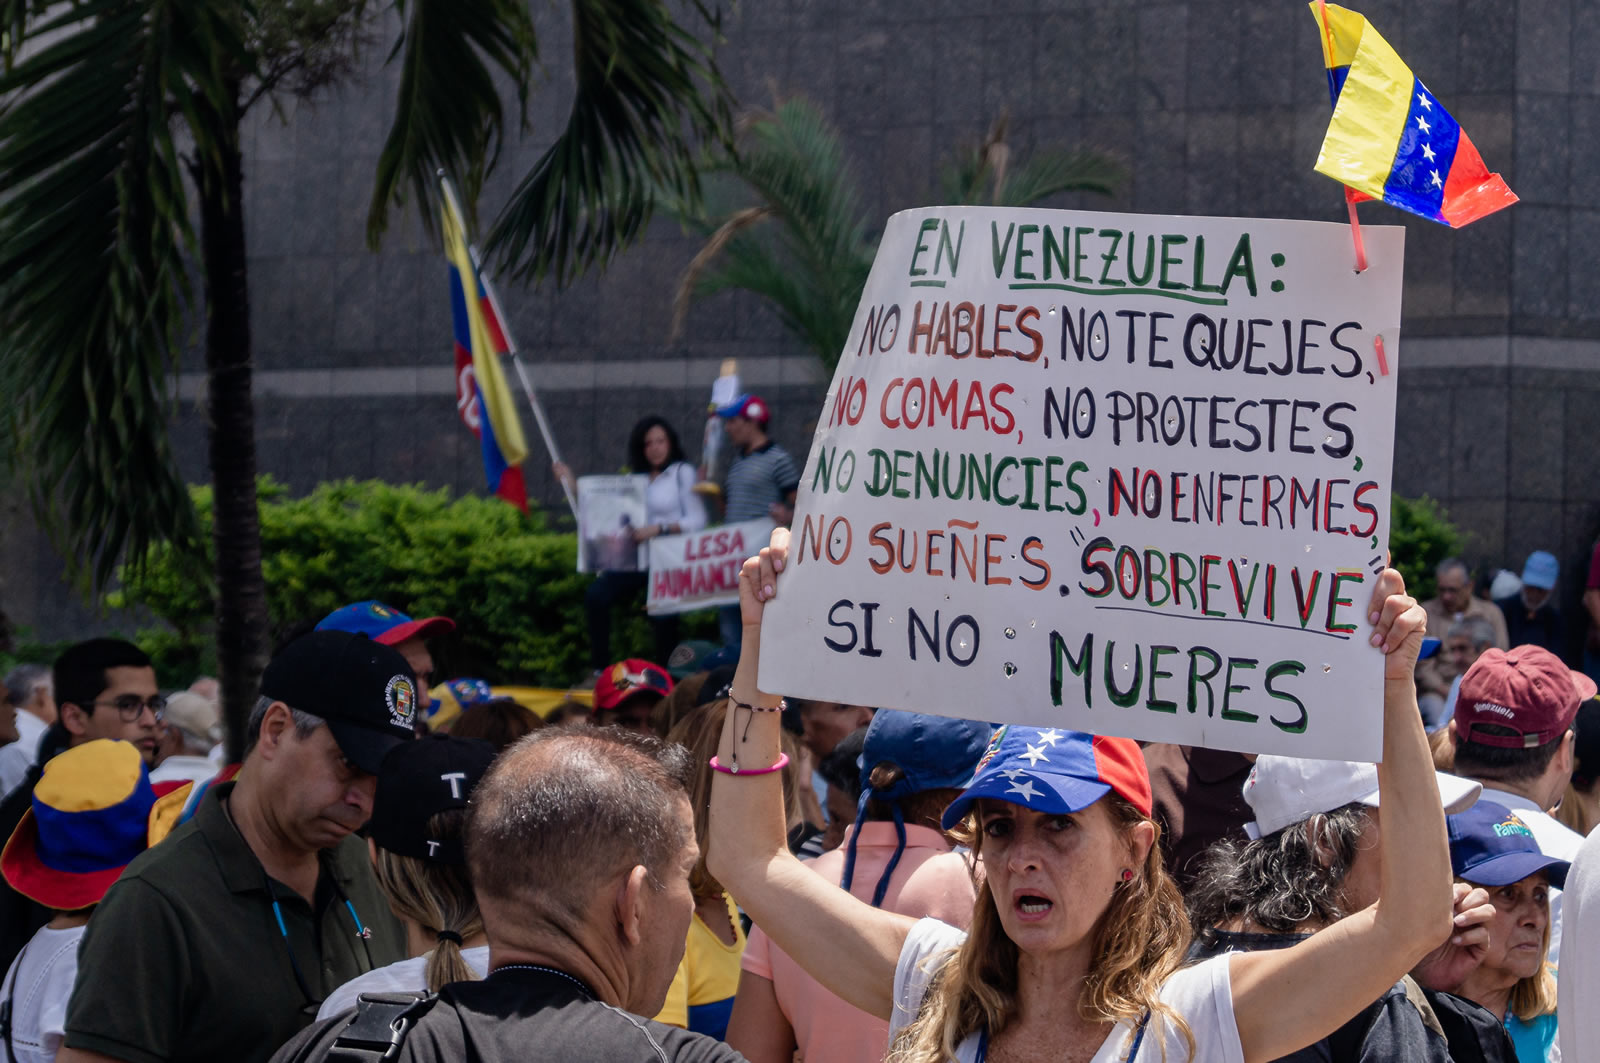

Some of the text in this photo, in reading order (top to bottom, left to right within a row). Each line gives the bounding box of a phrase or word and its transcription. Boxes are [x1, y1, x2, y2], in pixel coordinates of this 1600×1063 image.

[909, 218, 1286, 297] EN VENEZUELA:
[857, 300, 1376, 385] NO HABLES, NO TE QUEJES,
[828, 376, 1364, 472] NO COMAS, NO PROTESTES,
[812, 446, 1379, 550] NO DENUNCIES, NO ENFERMES,
[652, 556, 749, 600] HUMANI
[684, 528, 745, 563] LESA
[798, 514, 852, 566] NO
[868, 519, 1071, 597] SUEÑES.
[824, 599, 883, 657] SI
[1049, 630, 1309, 733] MUERES
[440, 772, 466, 799] T
[426, 840, 441, 857] T
